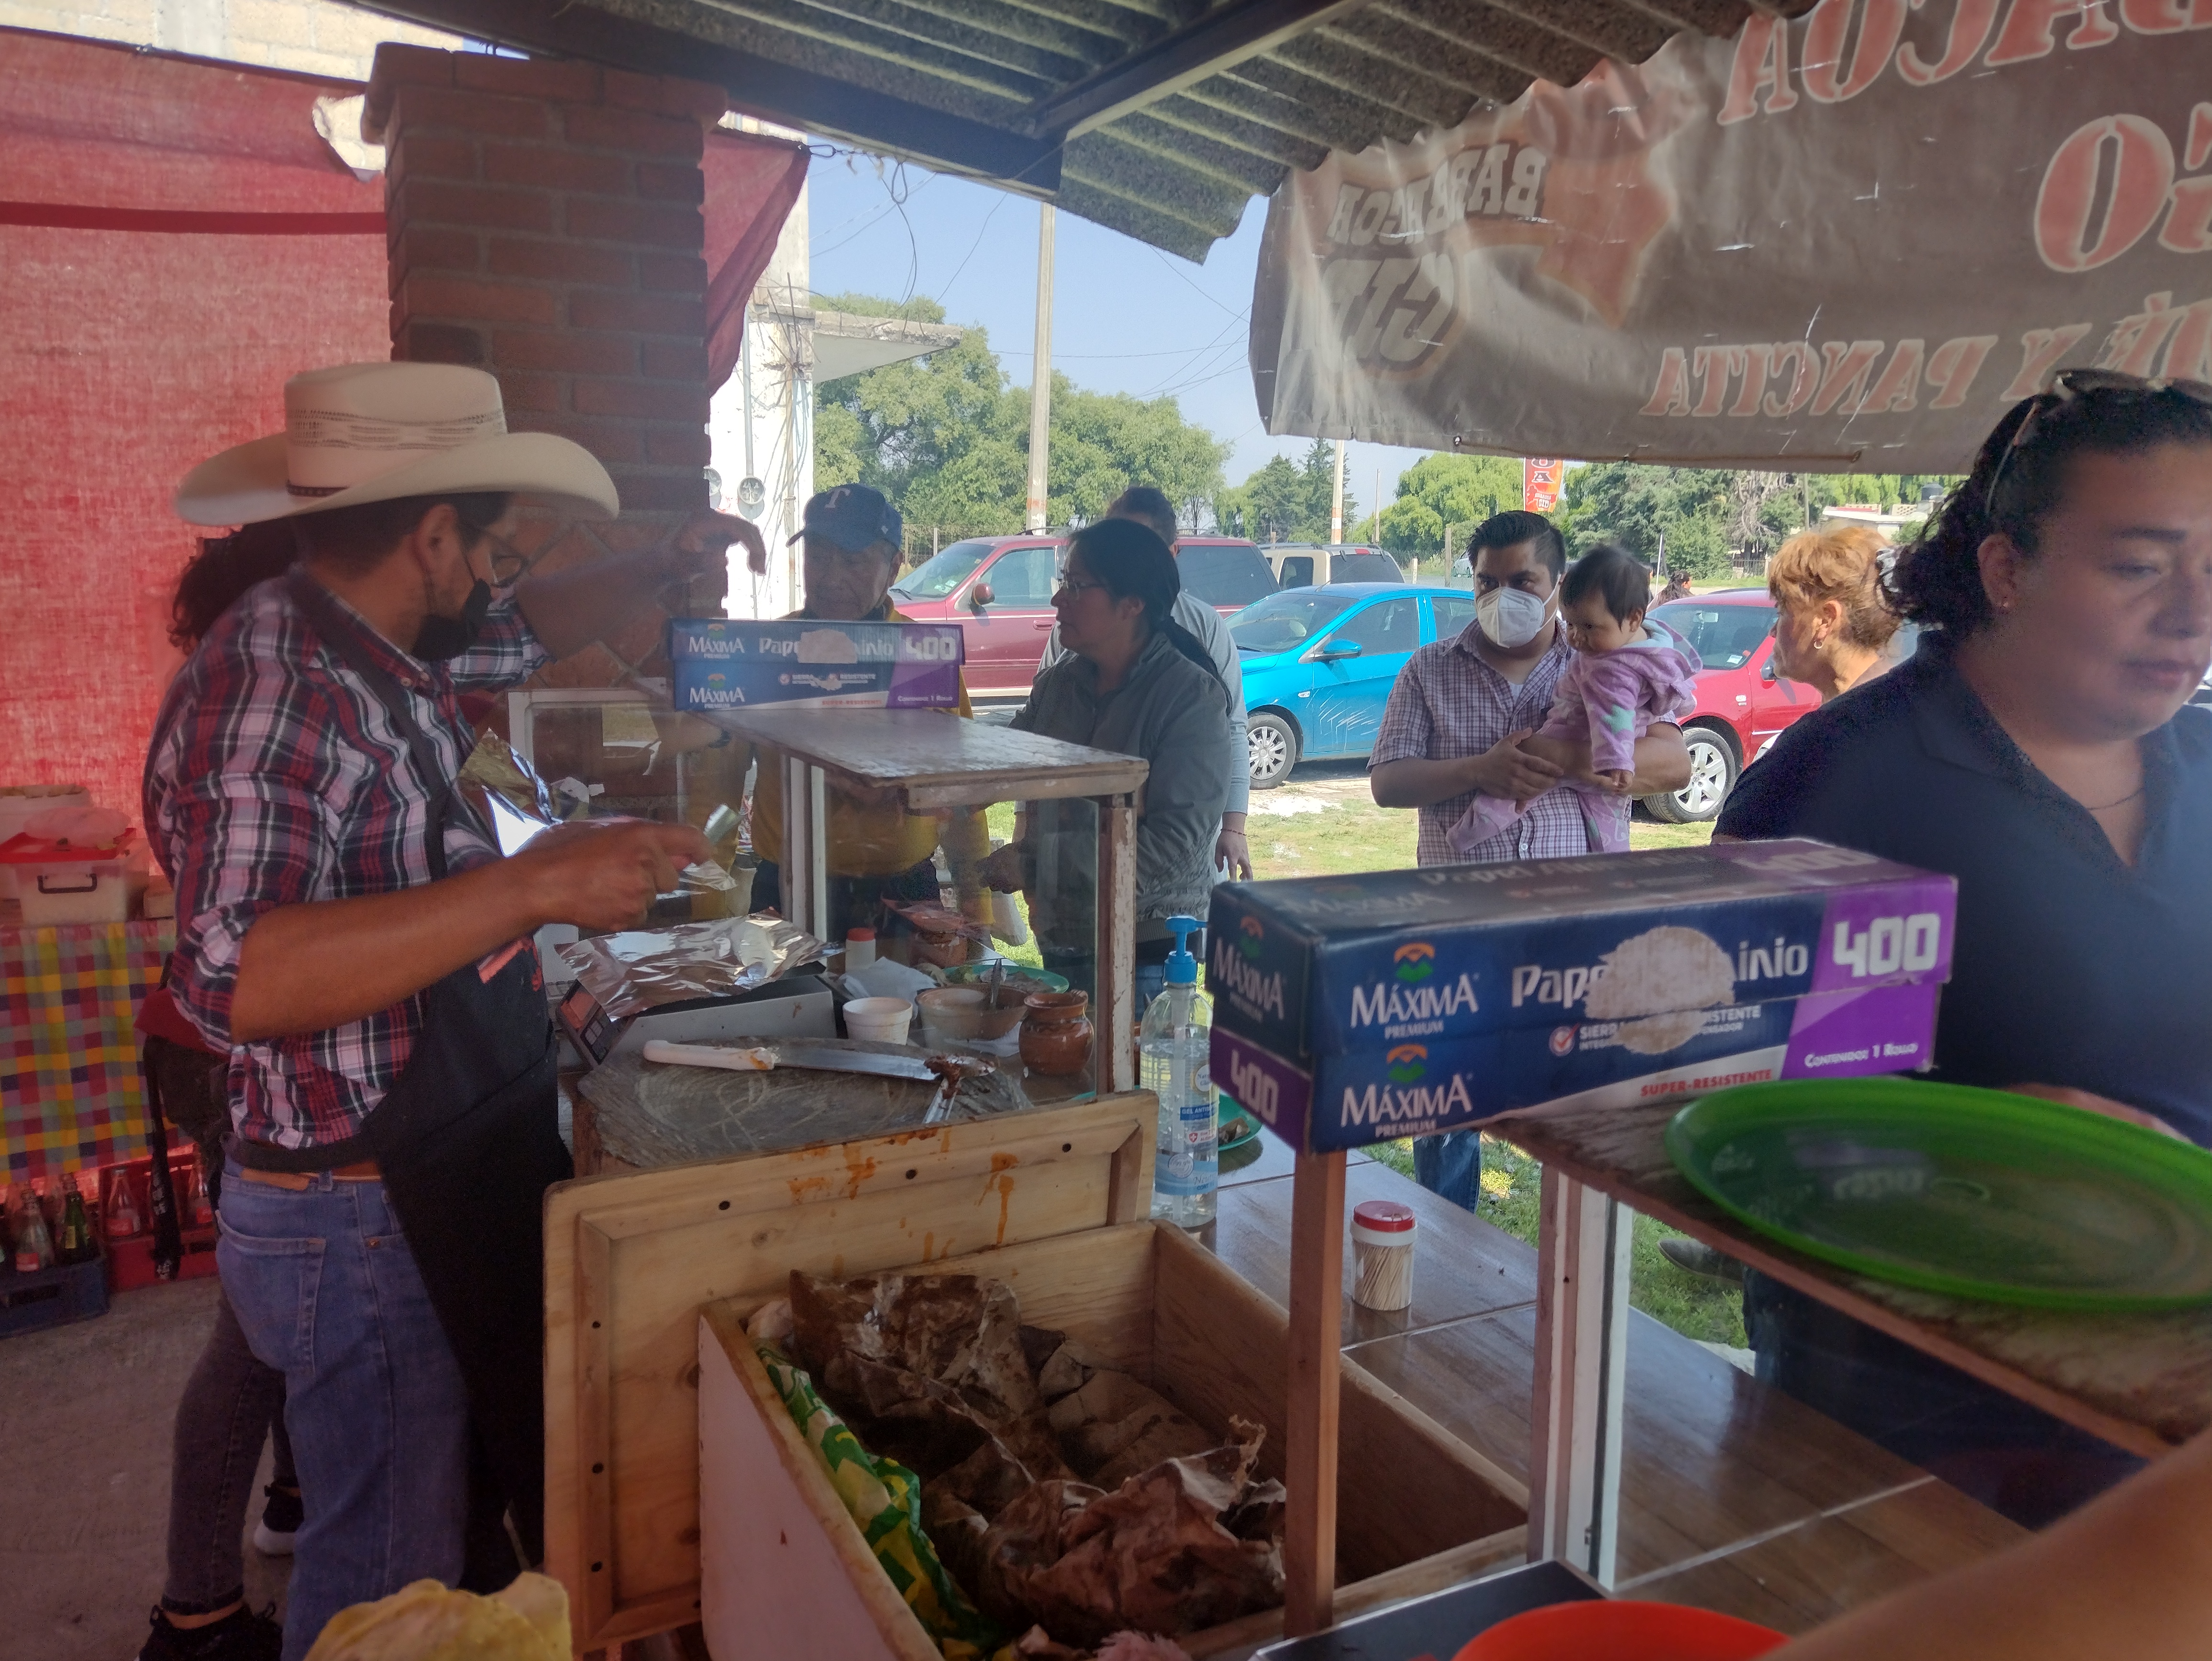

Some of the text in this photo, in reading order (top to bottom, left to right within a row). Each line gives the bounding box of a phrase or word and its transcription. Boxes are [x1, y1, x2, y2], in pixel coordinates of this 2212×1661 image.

[689, 636, 745, 653] MÁXIMA
[906, 636, 956, 661] 400
[689, 687, 745, 703] MÁXIMA
[1735, 937, 1808, 983] inio
[1833, 911, 1941, 978] 400
[1213, 936, 1284, 1020] MÁXIMA
[1350, 973, 1479, 1029] MÁXIMA
[1384, 1019, 1444, 1040] PREMIUM
[1872, 1044, 1880, 1058] 1
[1231, 1049, 1279, 1125] 400
[1340, 1073, 1473, 1127] MÁXIMA
[1641, 1068, 1773, 1097] SUPER-RESISTENTE
